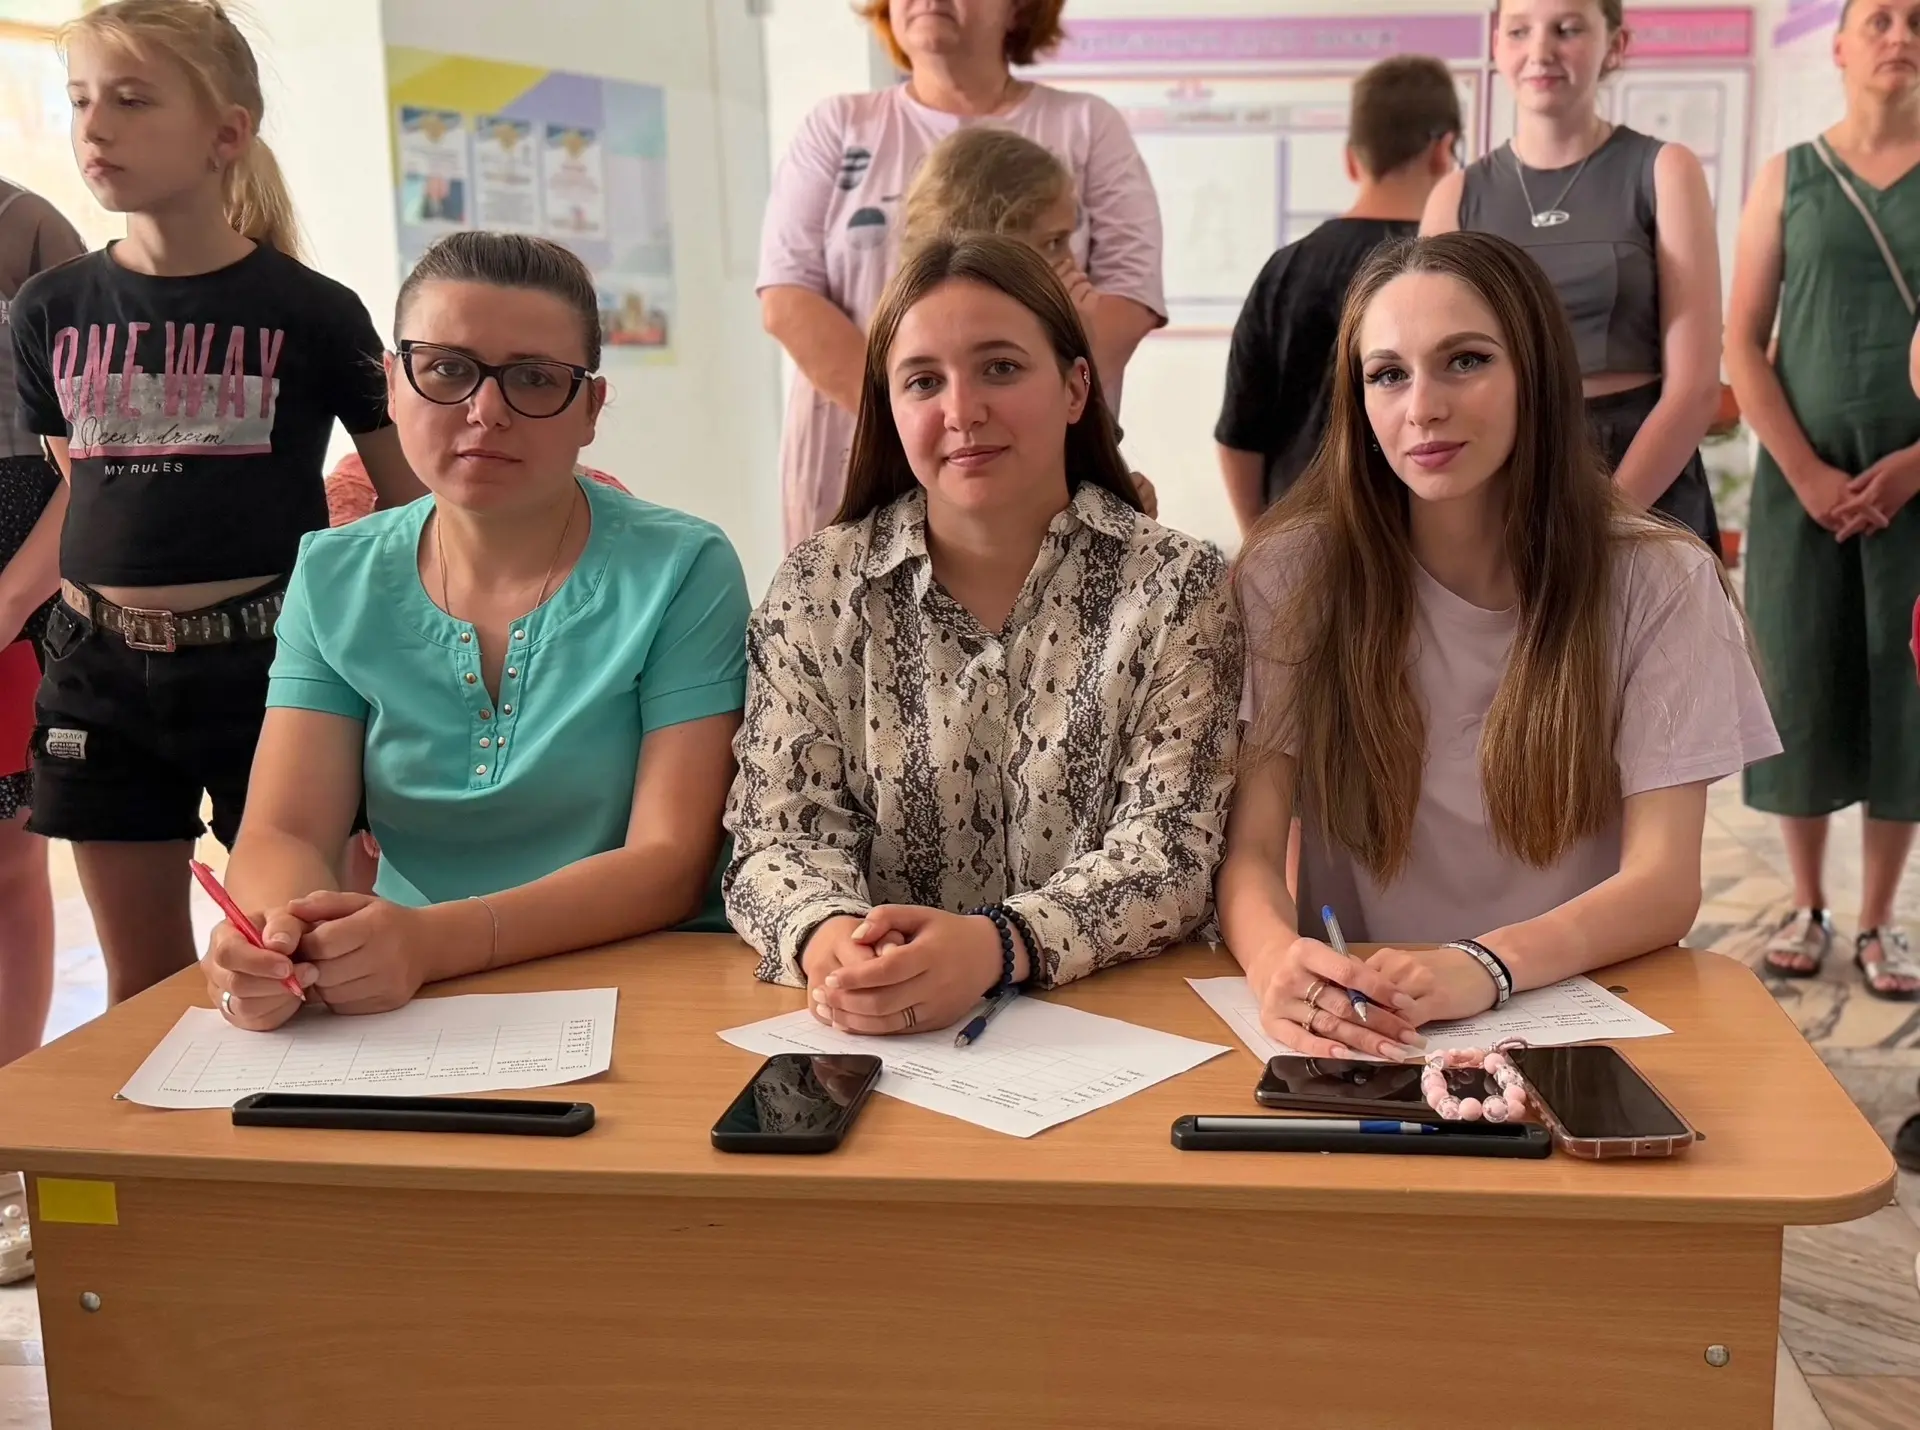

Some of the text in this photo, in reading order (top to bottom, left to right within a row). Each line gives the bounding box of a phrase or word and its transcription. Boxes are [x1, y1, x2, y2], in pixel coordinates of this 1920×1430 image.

[54, 322, 284, 421] ONE WAY
[104, 462, 183, 476] MY RULES
